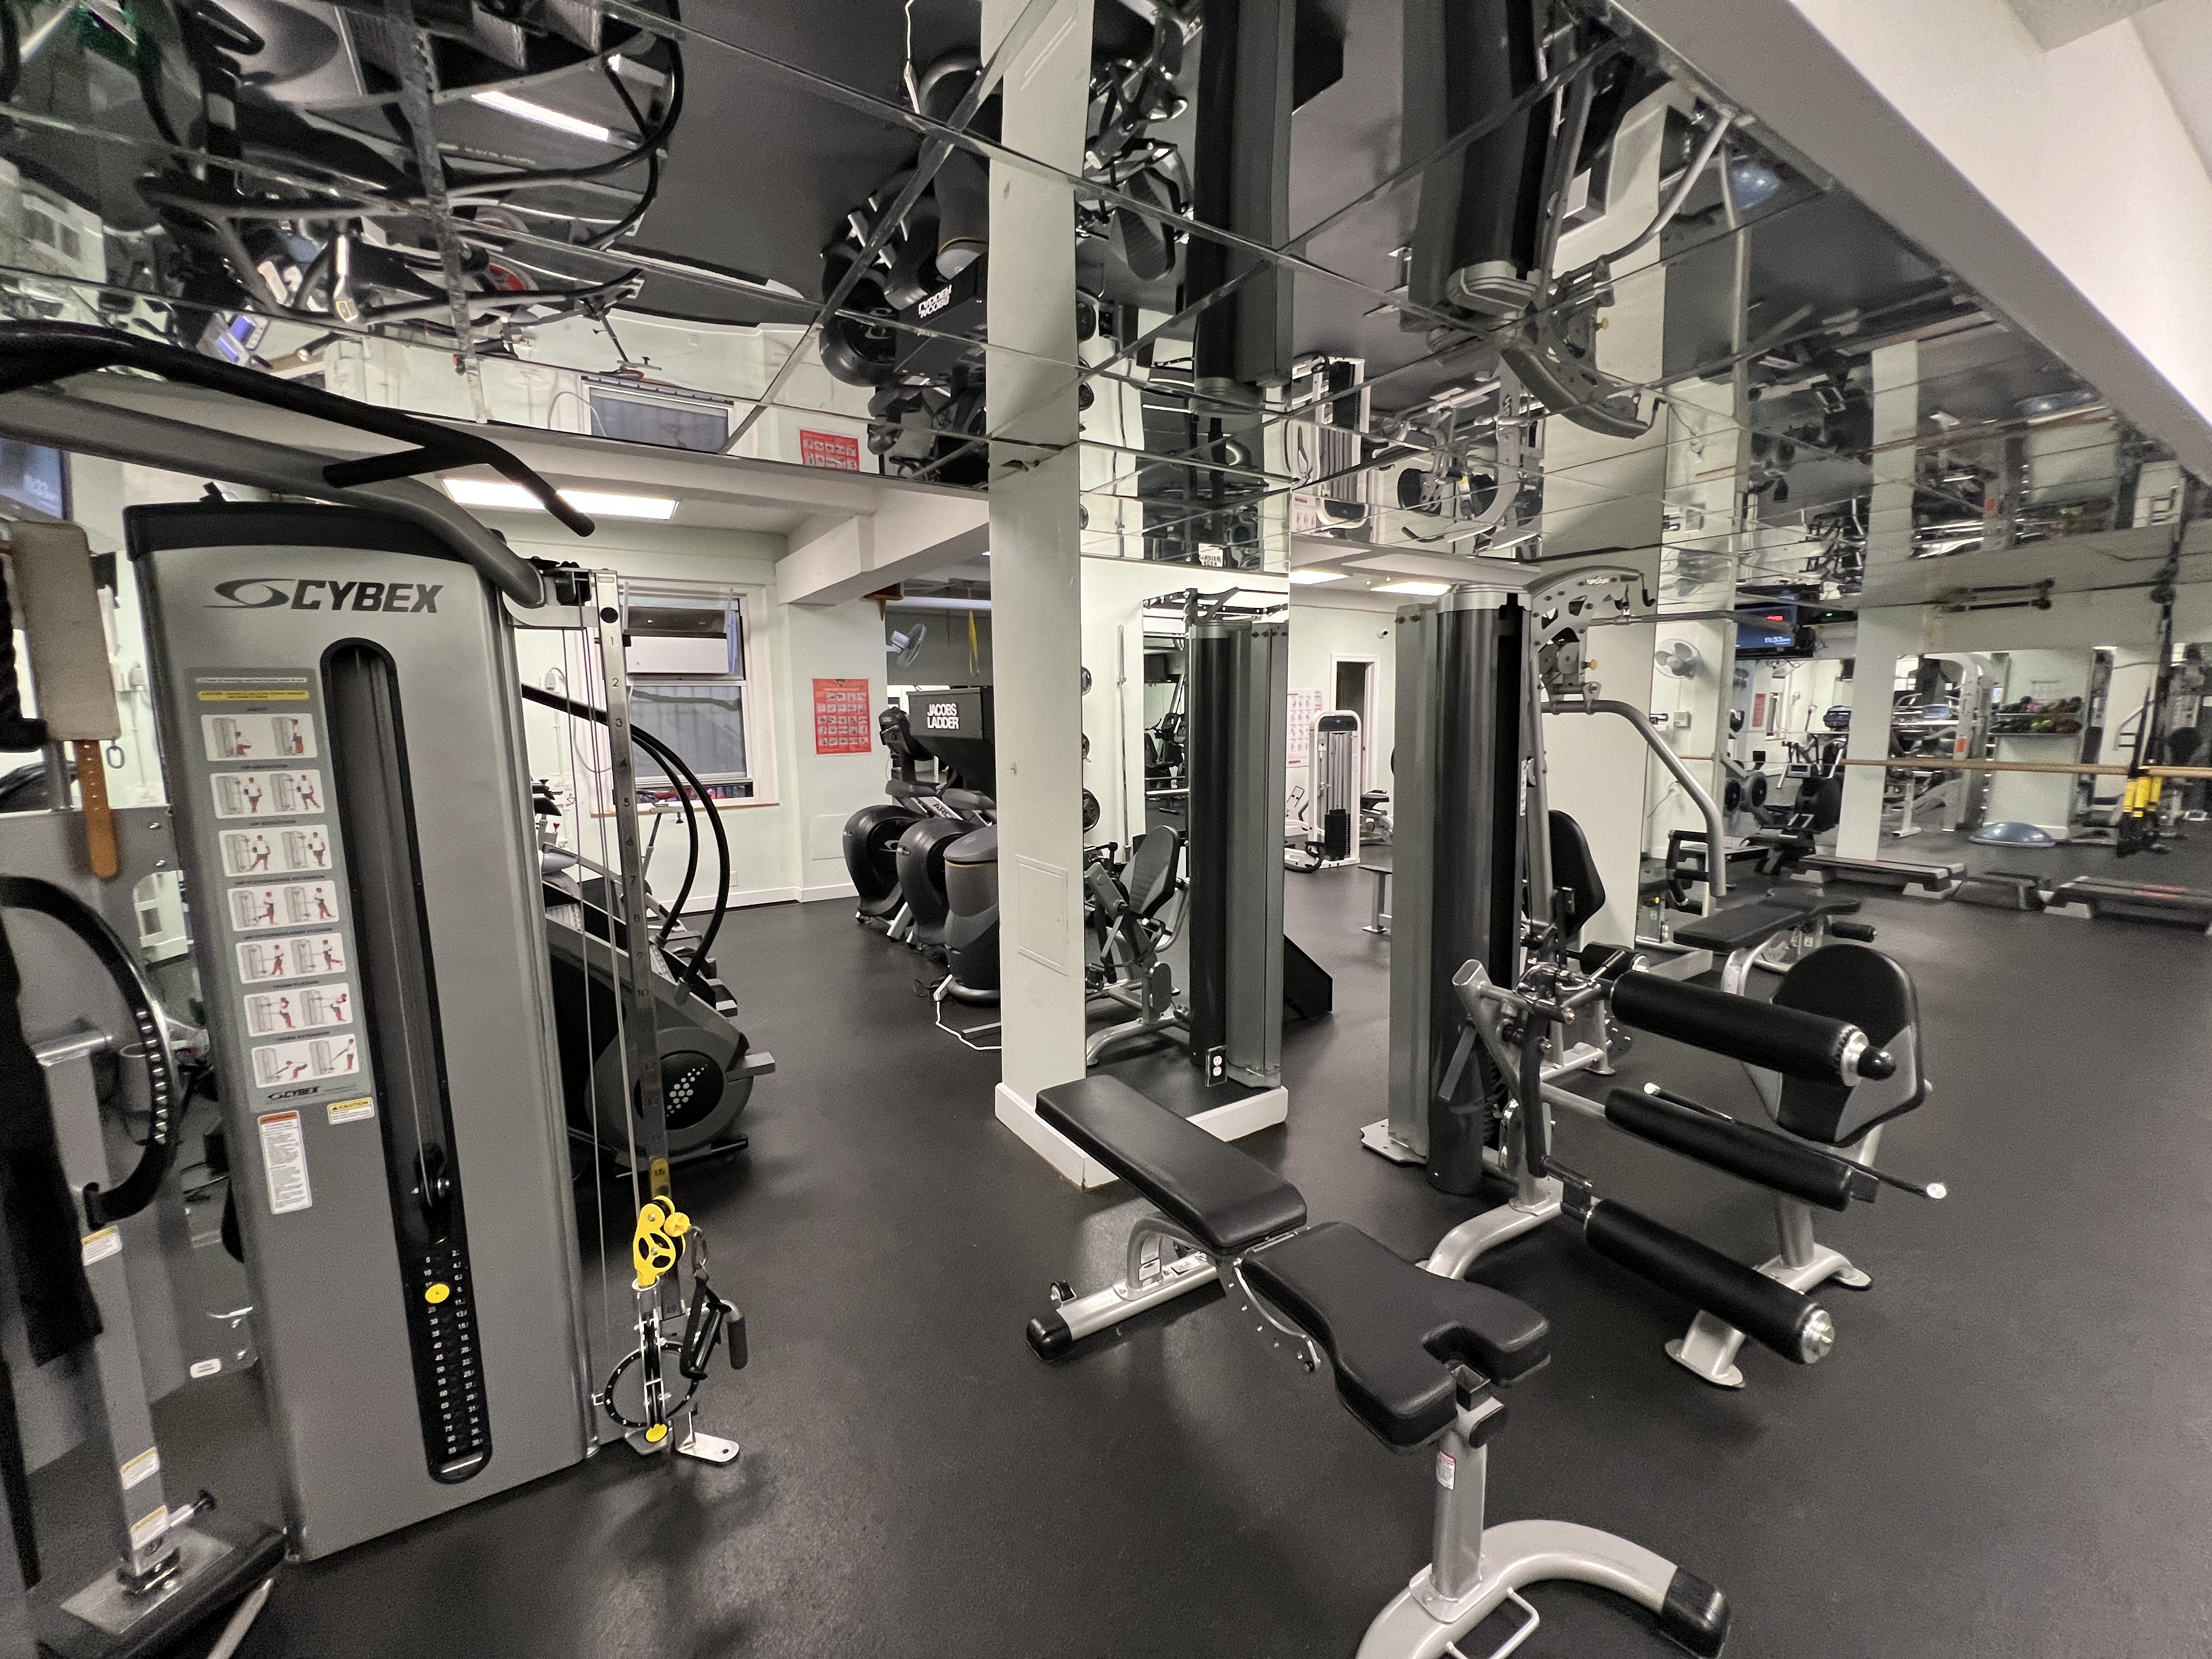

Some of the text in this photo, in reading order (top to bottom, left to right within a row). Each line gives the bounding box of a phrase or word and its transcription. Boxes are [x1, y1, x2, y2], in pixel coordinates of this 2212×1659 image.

[291, 579, 443, 613] CYBEX
[610, 636, 614, 646] 1
[612, 678, 619, 687] 2
[927, 703, 957, 716] JACOBS
[616, 718, 622, 727] 3
[927, 716, 959, 729] LADDER
[623, 798, 629, 806] 5
[627, 837, 633, 846] 6
[630, 876, 636, 884] 7
[634, 914, 640, 923] 8
[636, 952, 642, 961] 9
[637, 989, 649, 997] 10
[283, 1086, 320, 1098] CYBEX
[338, 1101, 369, 1109] CAUTION
